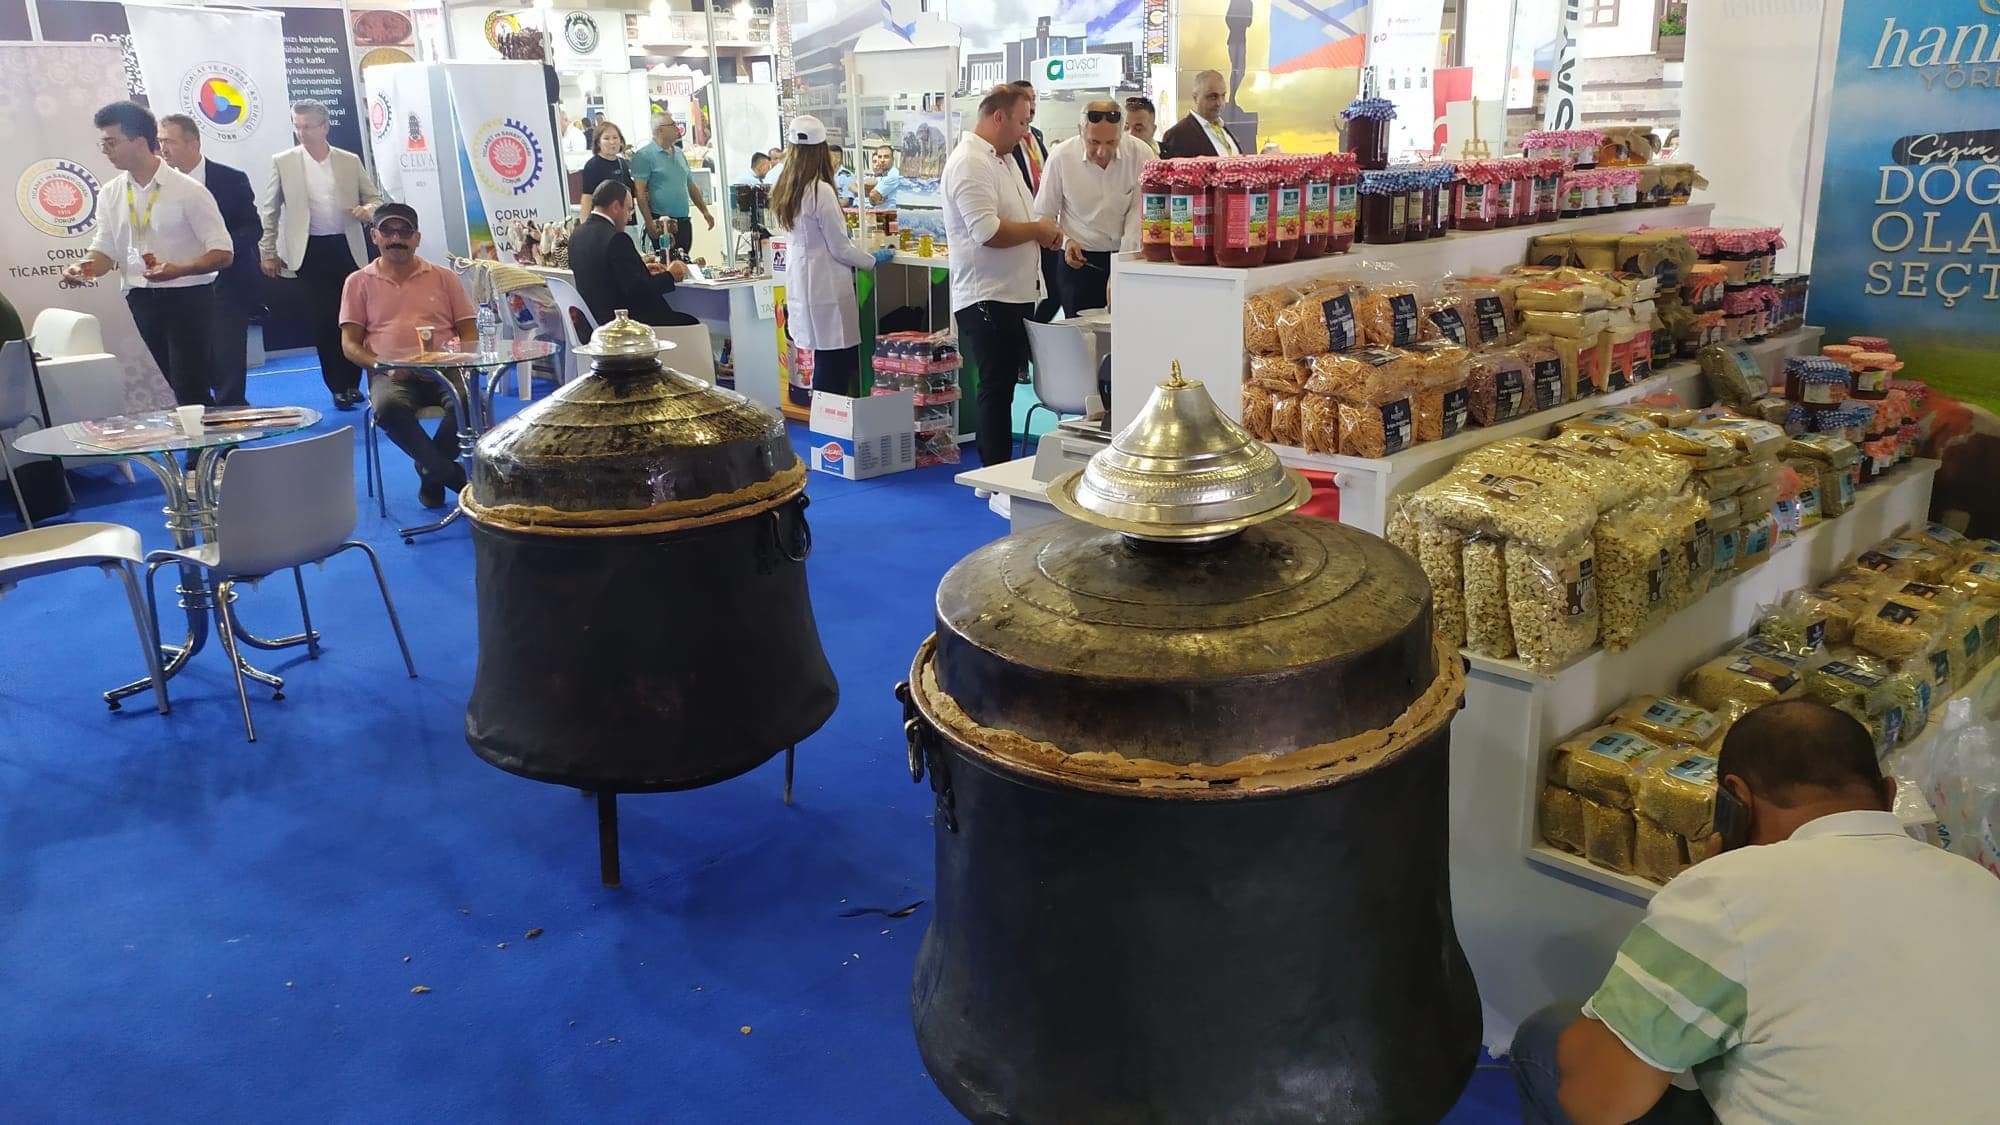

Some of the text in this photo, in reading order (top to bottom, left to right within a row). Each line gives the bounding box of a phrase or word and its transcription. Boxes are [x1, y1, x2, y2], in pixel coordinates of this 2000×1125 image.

[299, 35, 336, 44] korurken,
[313, 46, 339, 54] üretim
[294, 56, 304, 64] de
[306, 56, 326, 64] katkı
[292, 87, 343, 96] yeni nesillere
[1908, 134, 1994, 169] Sizin
[495, 208, 538, 222] ÇORUM
[9, 265, 65, 278] TİCARET
